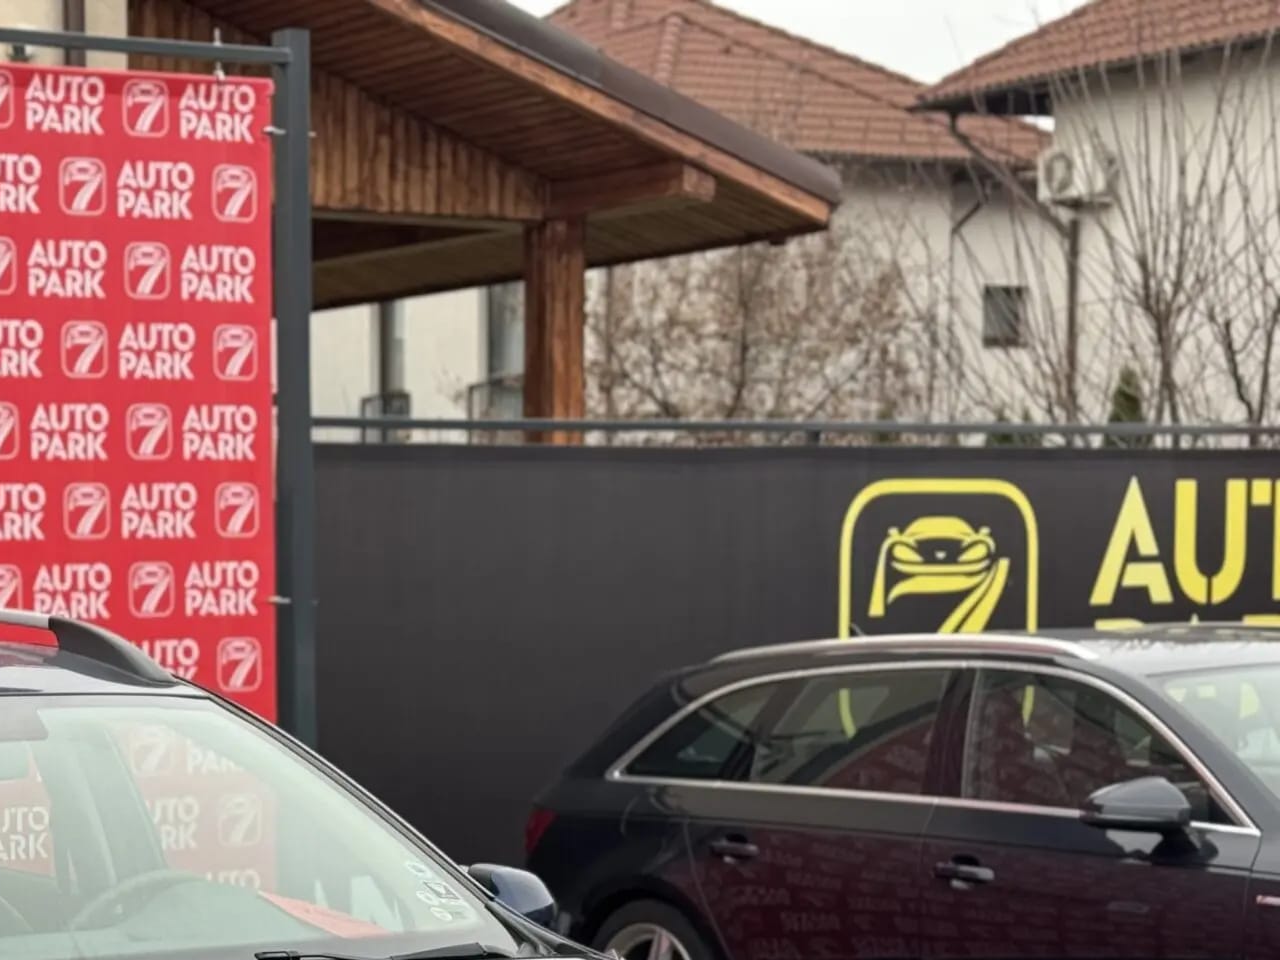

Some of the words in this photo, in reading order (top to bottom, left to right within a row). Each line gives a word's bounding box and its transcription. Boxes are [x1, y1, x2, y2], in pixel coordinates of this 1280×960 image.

[24, 76, 105, 107] AUTO
[179, 84, 256, 115] AUTO
[25, 104, 104, 136] PARK
[179, 112, 254, 143] PARK
[117, 162, 194, 193] AUTO
[118, 189, 192, 219] PARK
[28, 240, 106, 271] AUTO
[181, 245, 256, 276] AUTO
[28, 269, 106, 299] PARK
[181, 273, 254, 303] PARK
[118, 323, 195, 352] AUTO
[119, 351, 194, 381] PARK
[29, 403, 109, 433] AUTO
[182, 405, 256, 434] AUTO
[30, 431, 108, 461] PARK
[182, 432, 255, 462] PARK
[121, 482, 197, 512] AUTO
[121, 510, 196, 539] PARK
[32, 563, 111, 593] AUTO
[184, 561, 259, 590] AUTO
[34, 591, 110, 620] PARK
[184, 588, 258, 617] PARK
